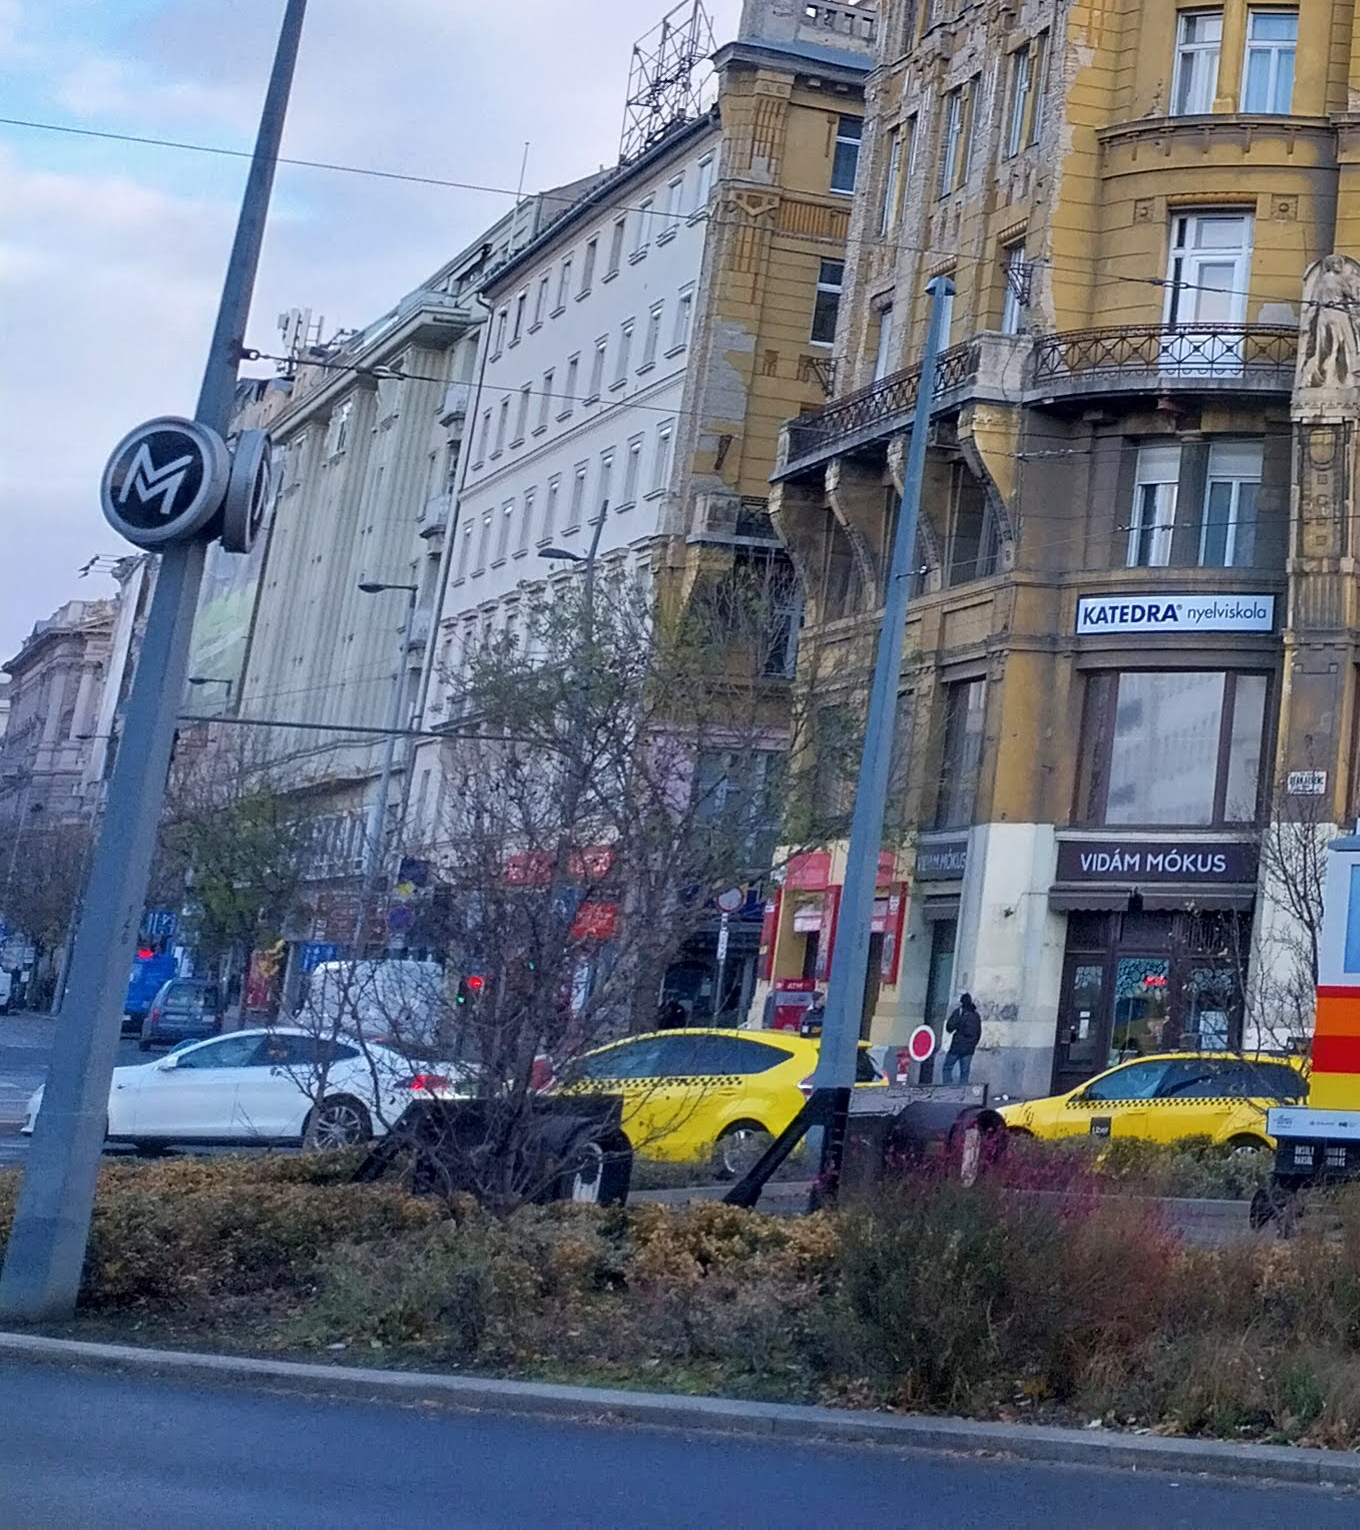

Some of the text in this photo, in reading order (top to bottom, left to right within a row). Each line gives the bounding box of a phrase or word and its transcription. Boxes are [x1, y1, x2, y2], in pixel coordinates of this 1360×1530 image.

[118, 443, 194, 515] M
[1187, 601, 1267, 624] nyelviskola
[1080, 848, 1226, 872] VIDÁM MÓKUS
